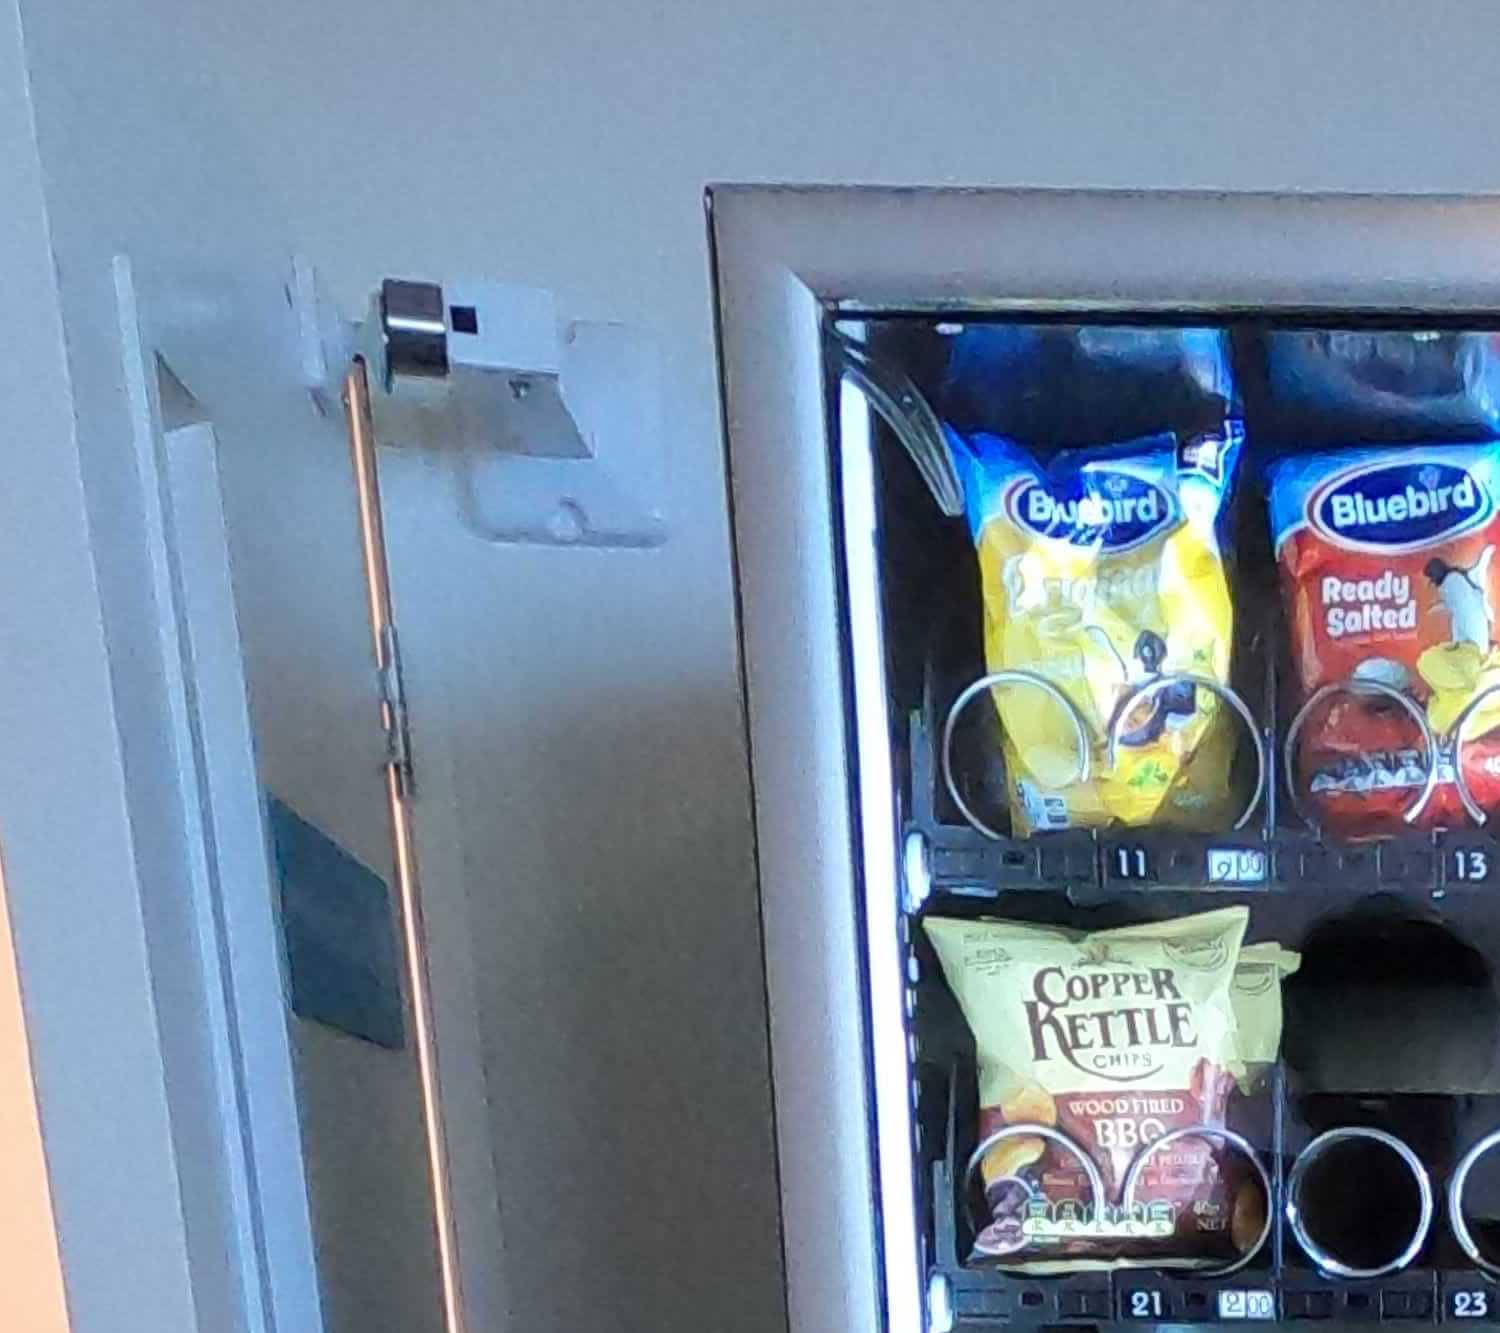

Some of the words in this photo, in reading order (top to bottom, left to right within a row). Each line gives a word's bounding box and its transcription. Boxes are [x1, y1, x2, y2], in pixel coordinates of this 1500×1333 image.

[1329, 474, 1478, 529] Bluebird
[1321, 570, 1410, 611] Ready
[1325, 599, 1417, 637] Salted
[1117, 849, 1148, 877] 11
[1454, 851, 1489, 880] 13
[1032, 965, 1182, 1008] COPPER
[1023, 1000, 1199, 1066] KETTLE
[1092, 1053, 1153, 1070] CHIPS
[1093, 1117, 1171, 1151] BBQ
[1131, 1292, 1161, 1316] 21
[1453, 1292, 1488, 1317] 23
